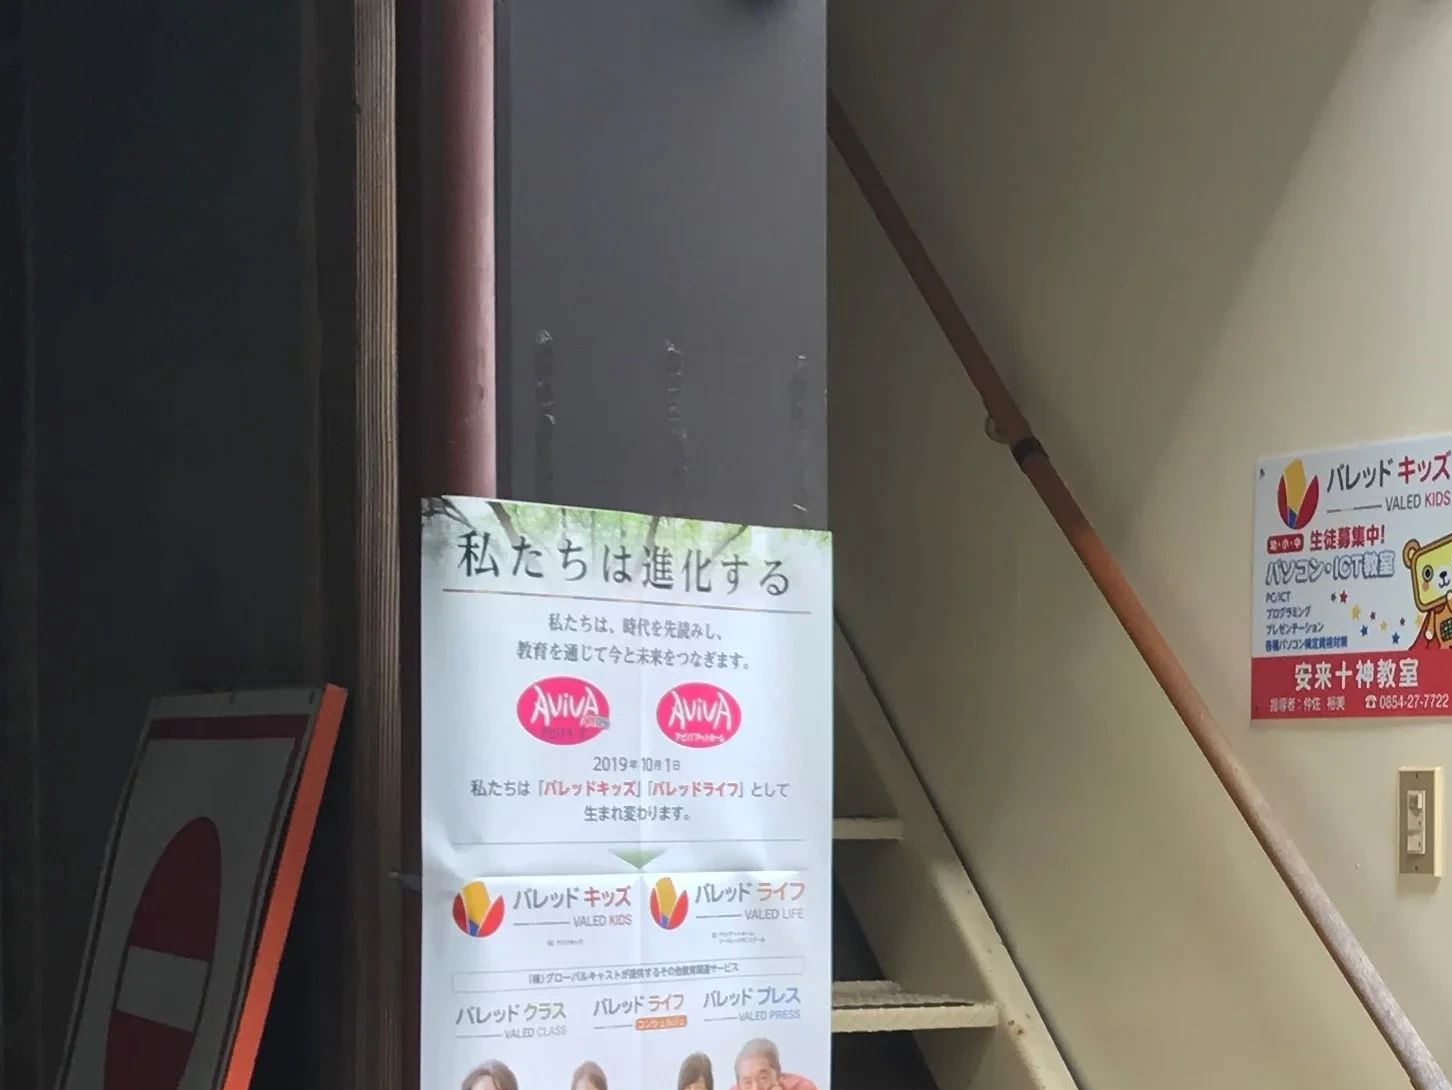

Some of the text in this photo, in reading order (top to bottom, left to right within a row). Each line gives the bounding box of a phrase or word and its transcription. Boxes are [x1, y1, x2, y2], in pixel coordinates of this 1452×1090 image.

[1398, 450, 1451, 484] キッズ
[1385, 489, 1451, 511] VALED KIDS
[457, 530, 790, 596] 私たちは進化する
[516, 640, 750, 671] 教育を通じて今と未来をつなぎます。
[1295, 657, 1419, 691] 安来十神教室
[584, 805, 690, 822] 生まれ変わります。
[583, 885, 632, 908] キッズ
[756, 881, 806, 901] ライフ
[573, 913, 632, 928] VALED KIDS
[745, 907, 804, 921] VALED LIFE
[524, 1002, 567, 1021] クラス
[649, 994, 684, 1012] ライフ
[739, 1008, 801, 1022] VALED PRESS
[505, 1025, 567, 1040] VALED CLASS
